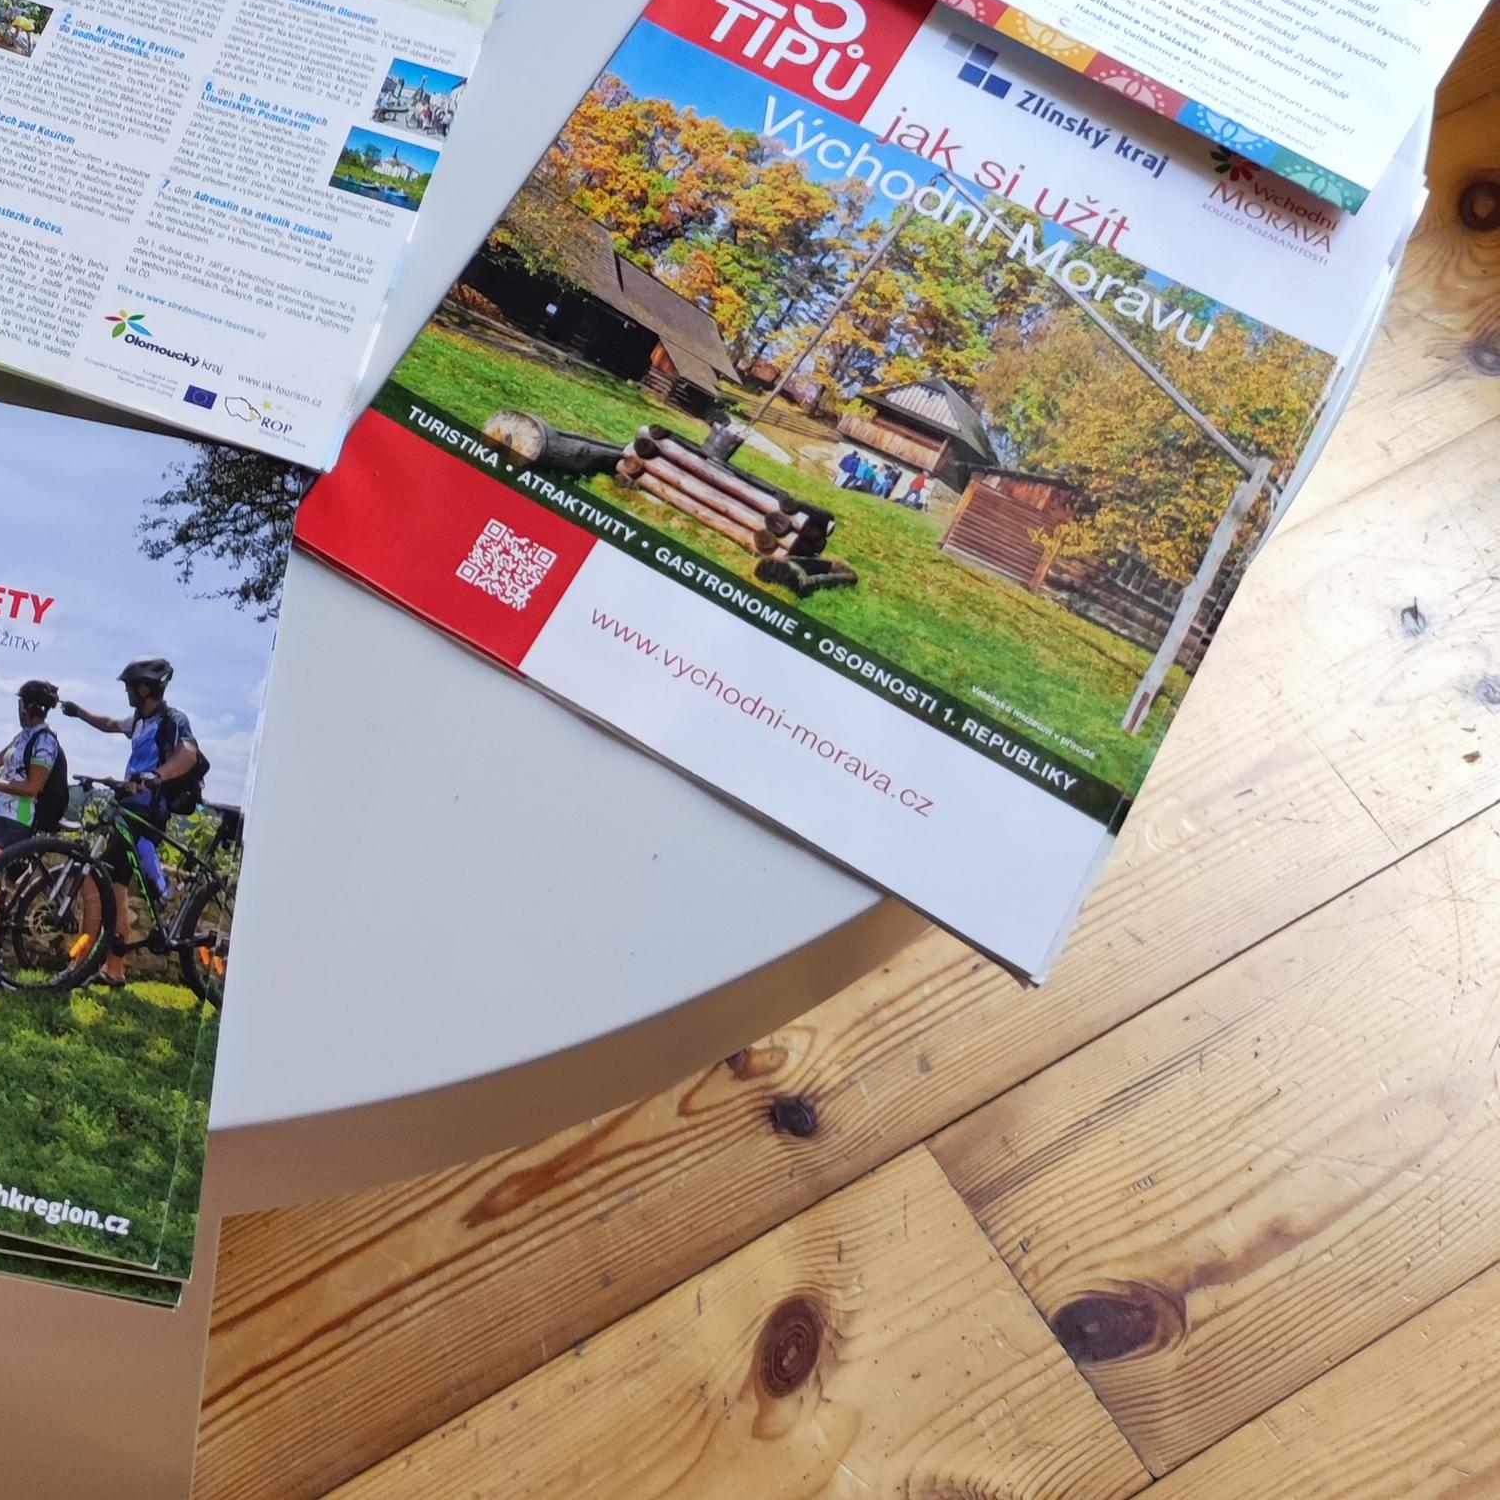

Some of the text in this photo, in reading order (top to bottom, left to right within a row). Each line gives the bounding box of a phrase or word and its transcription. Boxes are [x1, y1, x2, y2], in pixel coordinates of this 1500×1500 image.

[1015, 90, 1169, 179] Zlínský kraj
[194, 190, 239, 213] Adrenalin
[877, 106, 1132, 252] jak si užít
[1208, 180, 1331, 254] MORAVA
[761, 94, 1217, 354] Východní Moravu
[124, 334, 223, 376] Olomoucký kraj
[237, 373, 322, 407] www.ok-tourism.cz
[261, 416, 292, 434] ROP
[406, 405, 1078, 791] TURISTIKA ATRAKTIVITY GASTRONOMIE OSOBNOSTI 1. REPUBLIKY
[589, 604, 935, 819] www.vychodni-morava.cz
